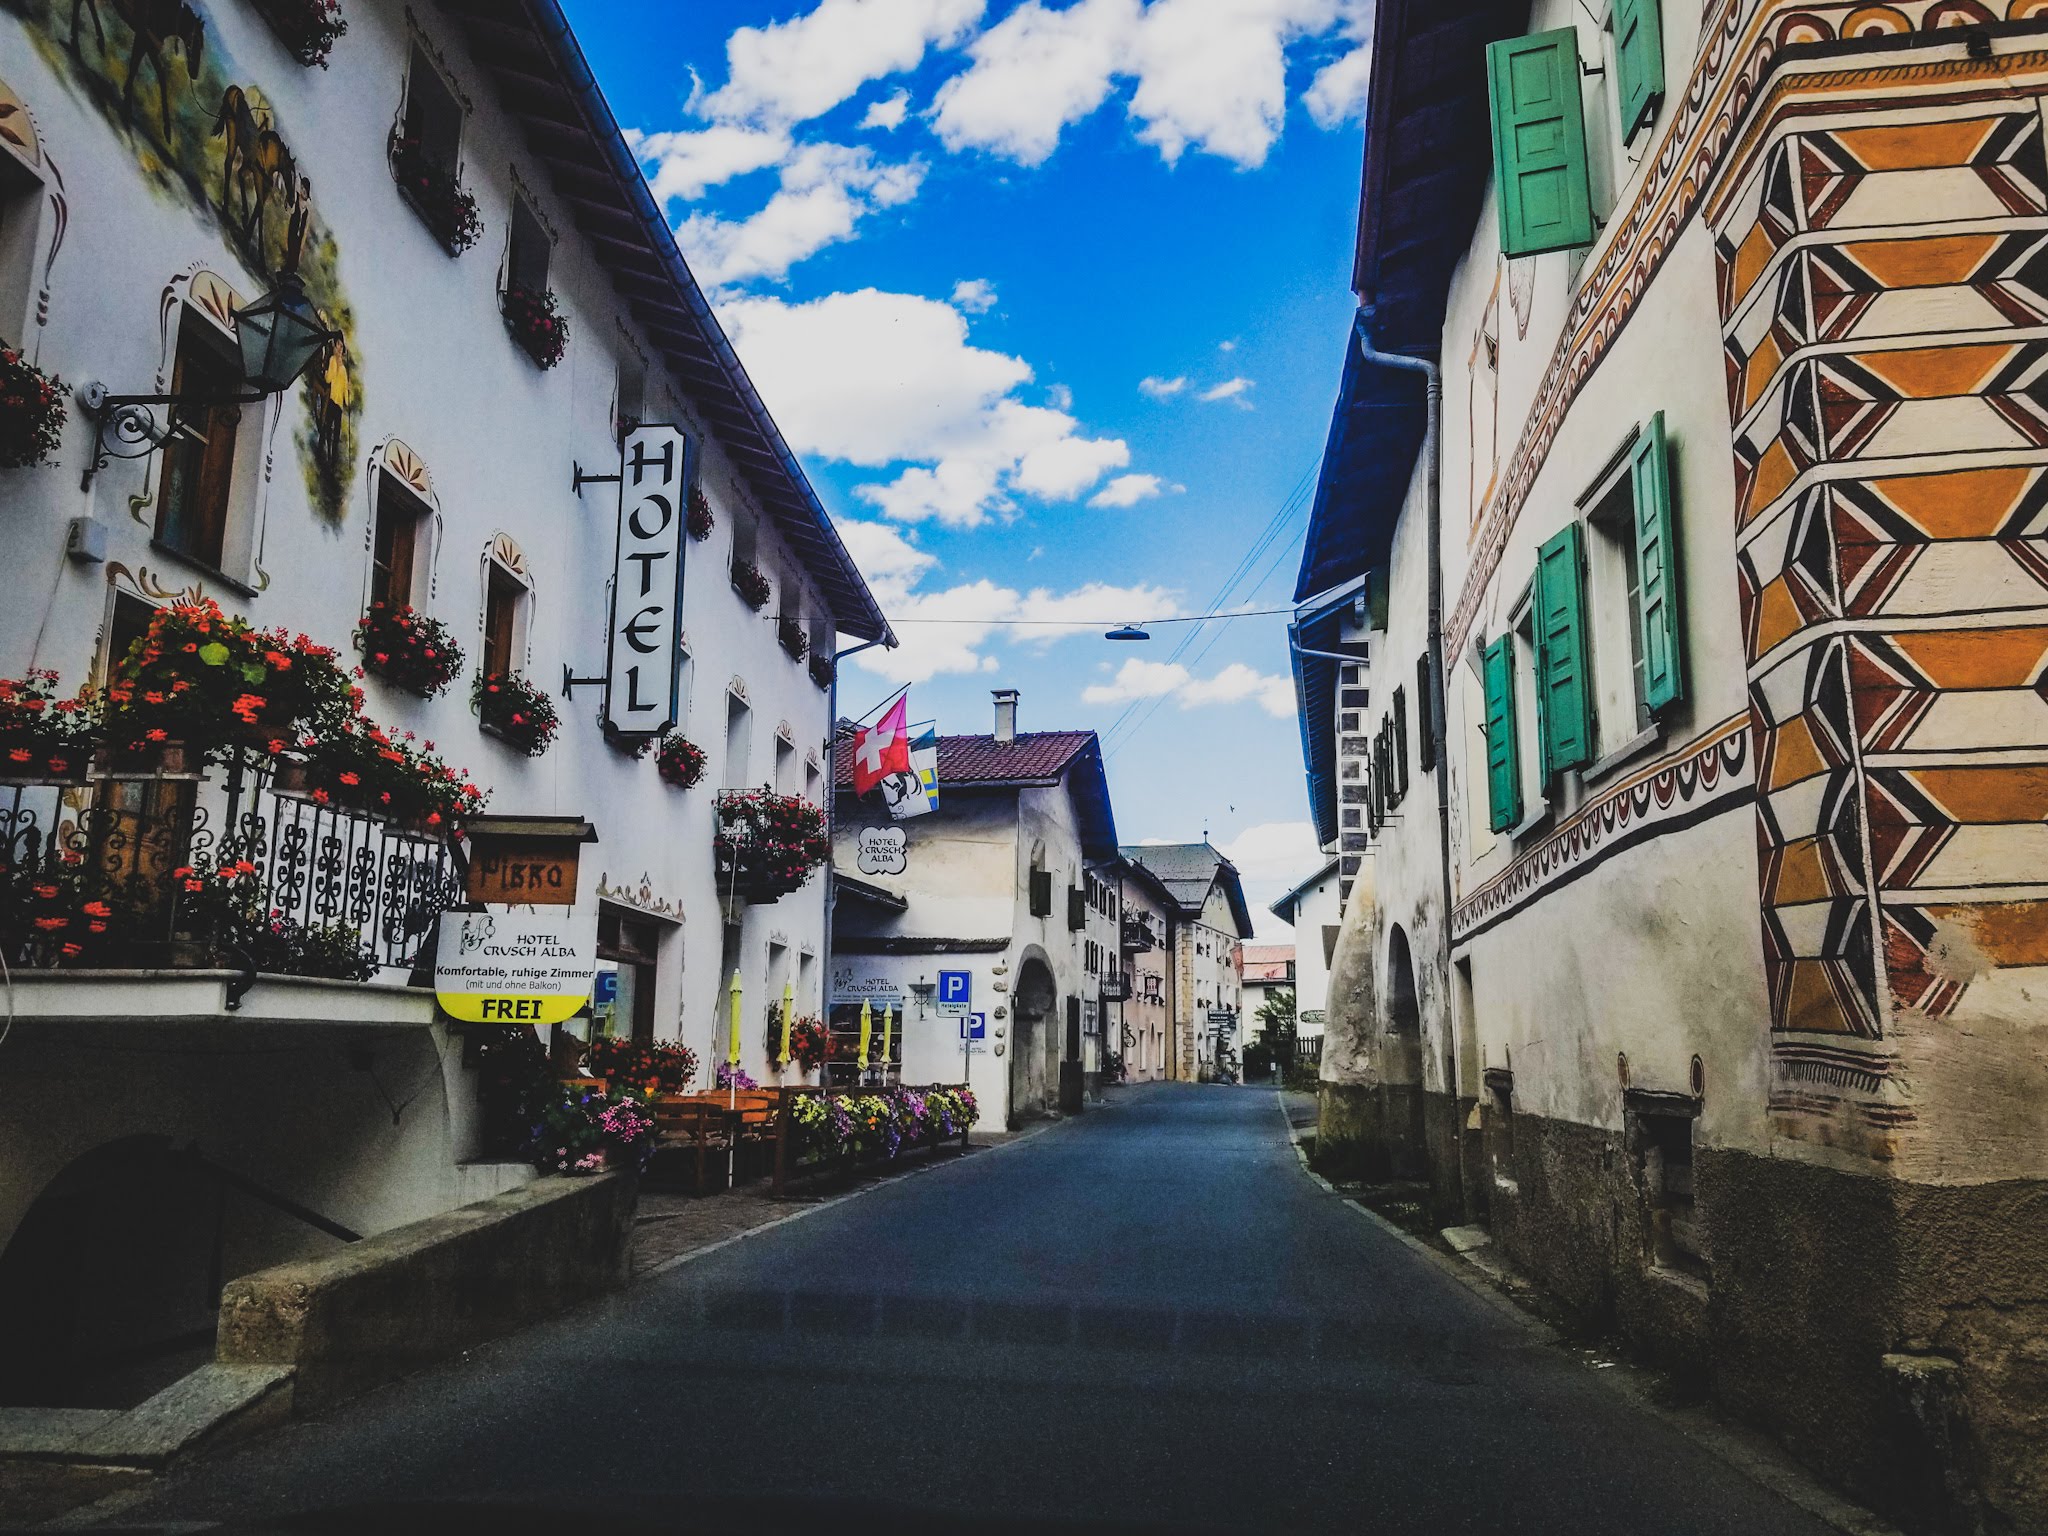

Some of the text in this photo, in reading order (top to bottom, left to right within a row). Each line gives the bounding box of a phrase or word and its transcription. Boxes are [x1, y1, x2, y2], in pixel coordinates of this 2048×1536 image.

[619, 439, 674, 712] HOTEL
[869, 838, 898, 846] HOTEL
[865, 846, 901, 854] CRUSCH
[517, 935, 560, 945] HOTEL
[483, 946, 576, 957] CRUSCH ALBA
[436, 966, 594, 980] Komfortable, ruhige Zimmer
[465, 980, 562, 991] (mit und ohne Balkon)
[948, 976, 963, 999] P
[481, 999, 543, 1019] FREI
[963, 1015, 982, 1037] P
